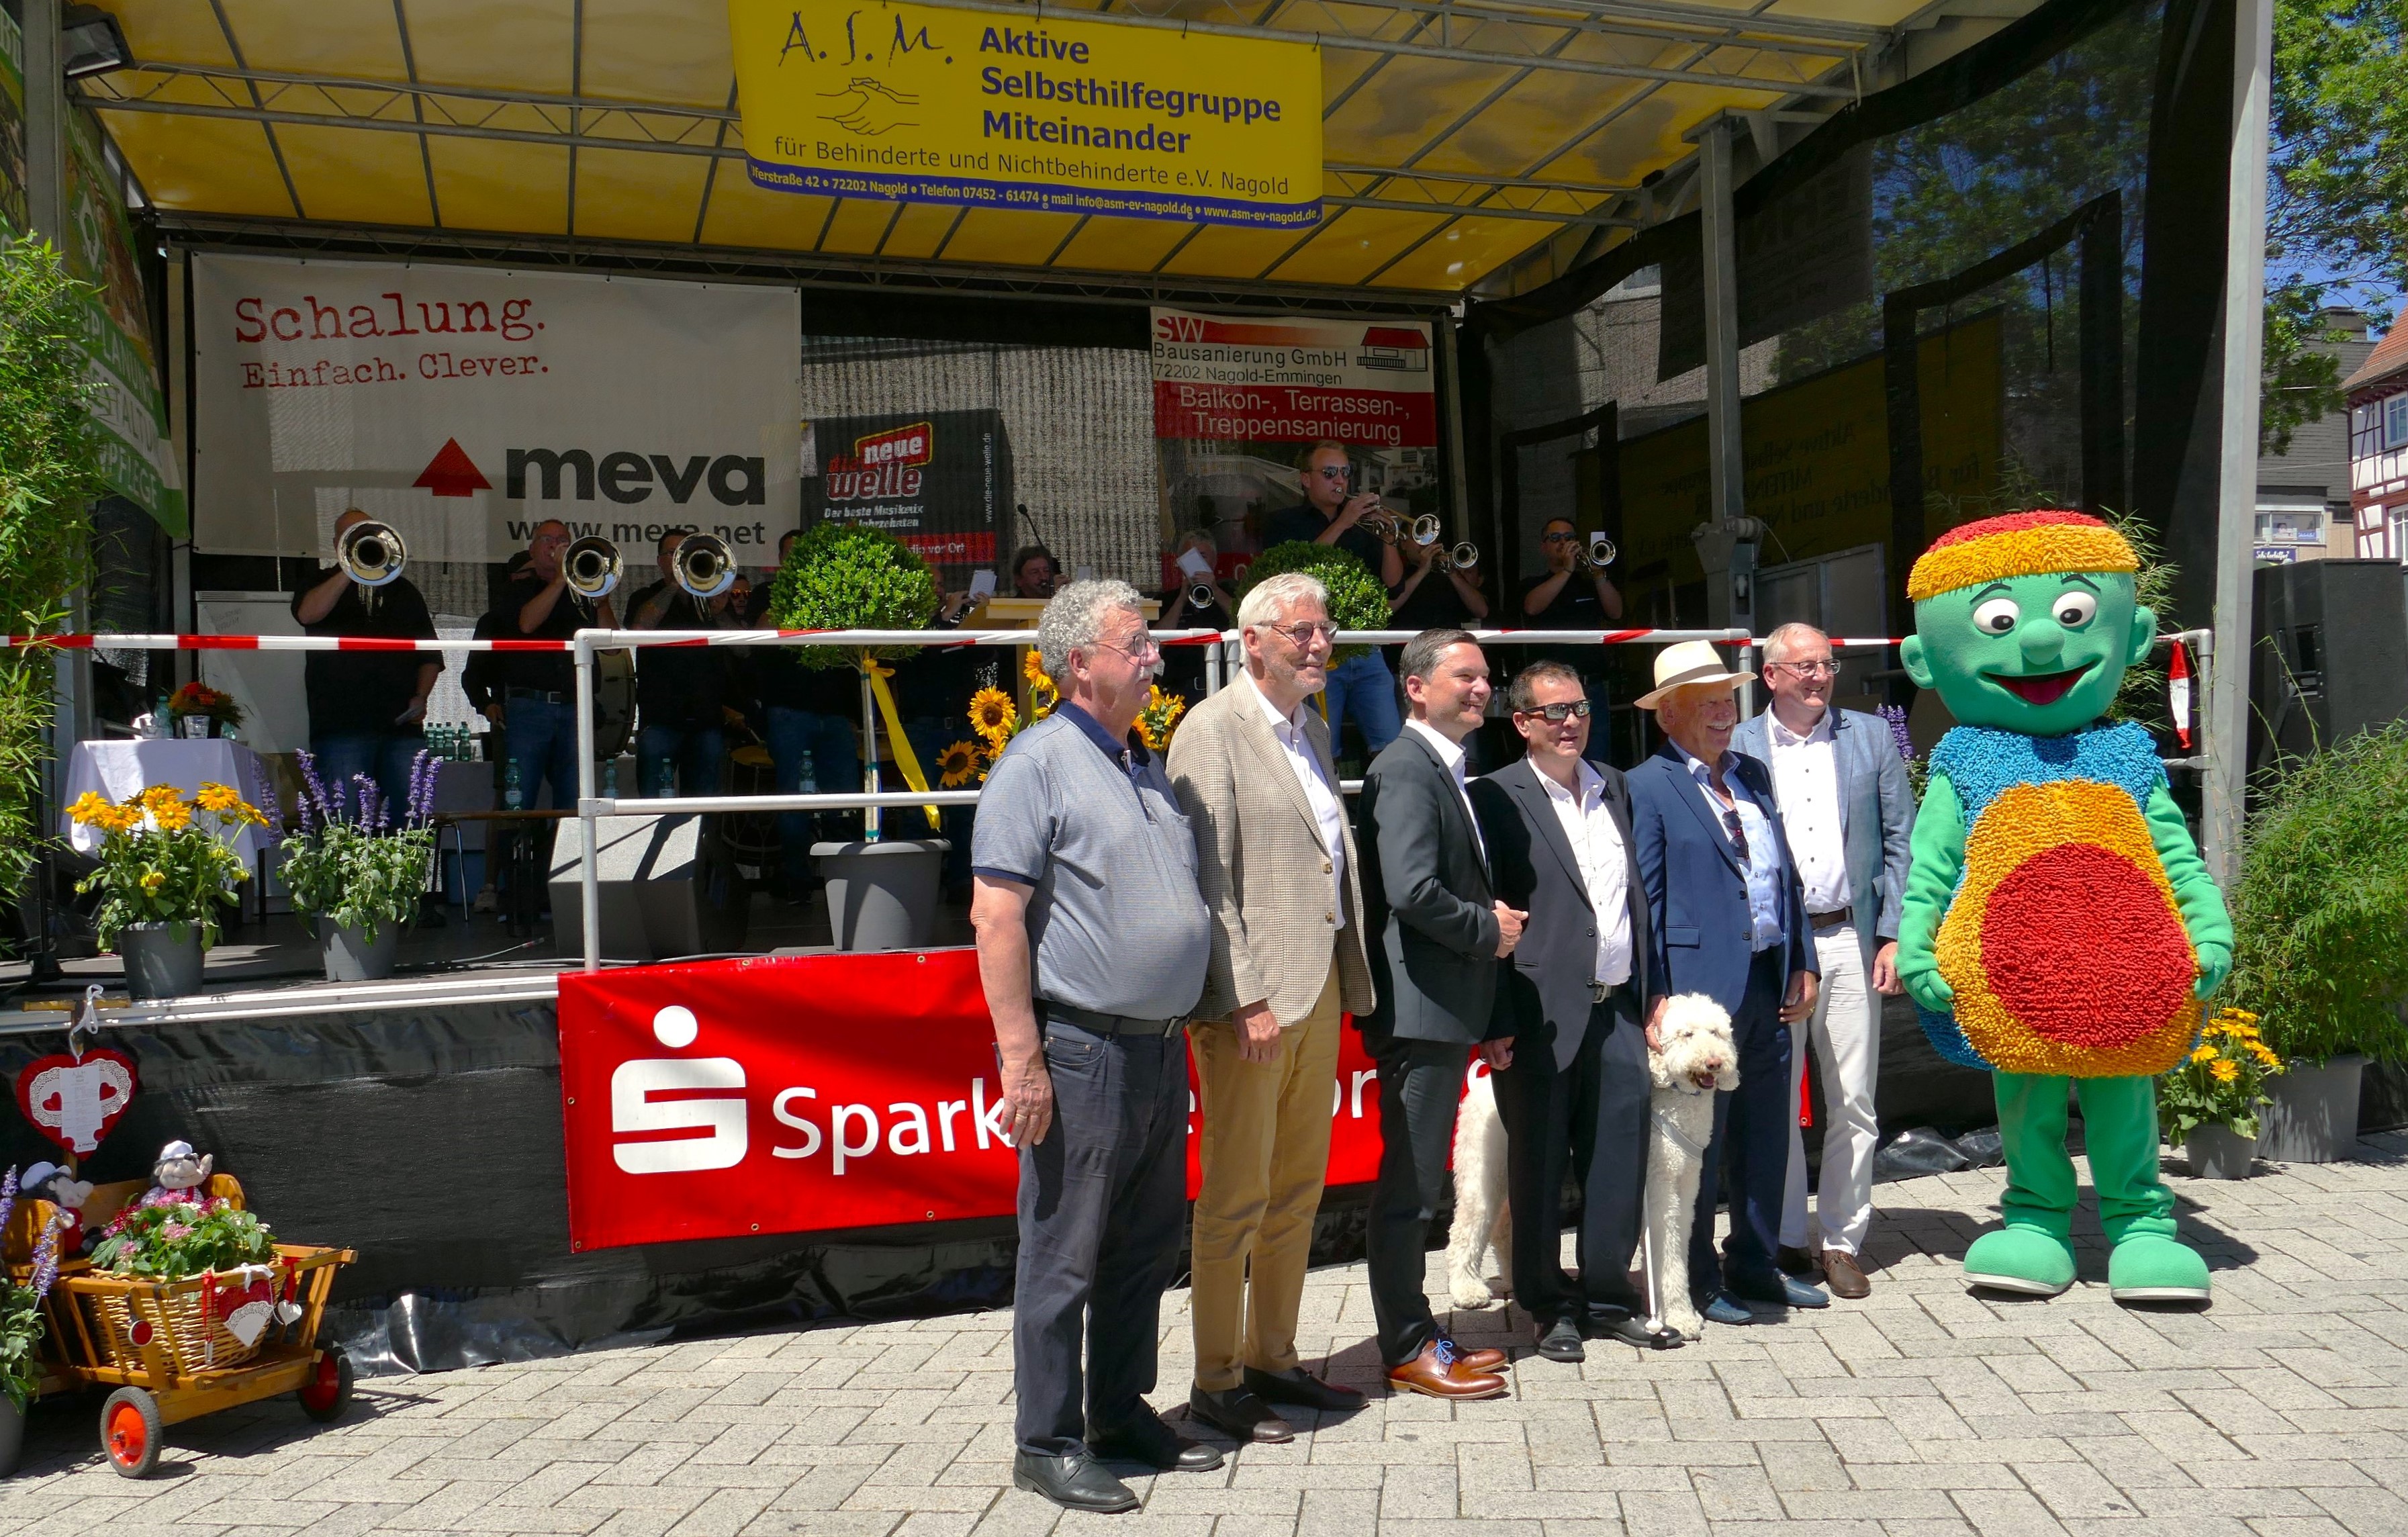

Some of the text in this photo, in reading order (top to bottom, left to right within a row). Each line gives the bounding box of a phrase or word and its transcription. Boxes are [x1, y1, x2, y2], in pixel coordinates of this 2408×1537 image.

[980, 27, 1089, 64] Aktive
[981, 66, 1281, 125] Selbsthilfegruppe
[983, 109, 1191, 154] Miteinander
[775, 136, 1290, 197] für Behinderte und Nichtbehinderte e.V. Nagold
[804, 175, 820, 188] 42
[831, 177, 868, 193] 72202
[870, 180, 907, 196] Nagold
[919, 183, 960, 199] Telefon
[962, 186, 997, 201] 07452
[1006, 189, 1039, 203] 61474
[1051, 193, 1074, 206] mail
[1076, 195, 1193, 216] info@asm-ev-nagold.de
[1203, 205, 1317, 224] www.asm-ev-nagold.de
[235, 291, 546, 344] Schalung.
[1156, 316, 1207, 343] SW
[240, 352, 549, 389] Einfach. Clever.
[1153, 342, 1347, 368] Bausanierung GmbH
[1154, 363, 1342, 387] 72202 Nagold-Emmingen
[1179, 385, 1411, 420] Balkon-, Terrassen-,
[1192, 411, 1401, 445] Treppensanierung
[864, 436, 923, 465] neue
[505, 447, 766, 506] meva
[826, 461, 923, 501] welle
[823, 507, 843, 518] Der
[843, 506, 872, 517] beste
[947, 542, 966, 553] Ort
